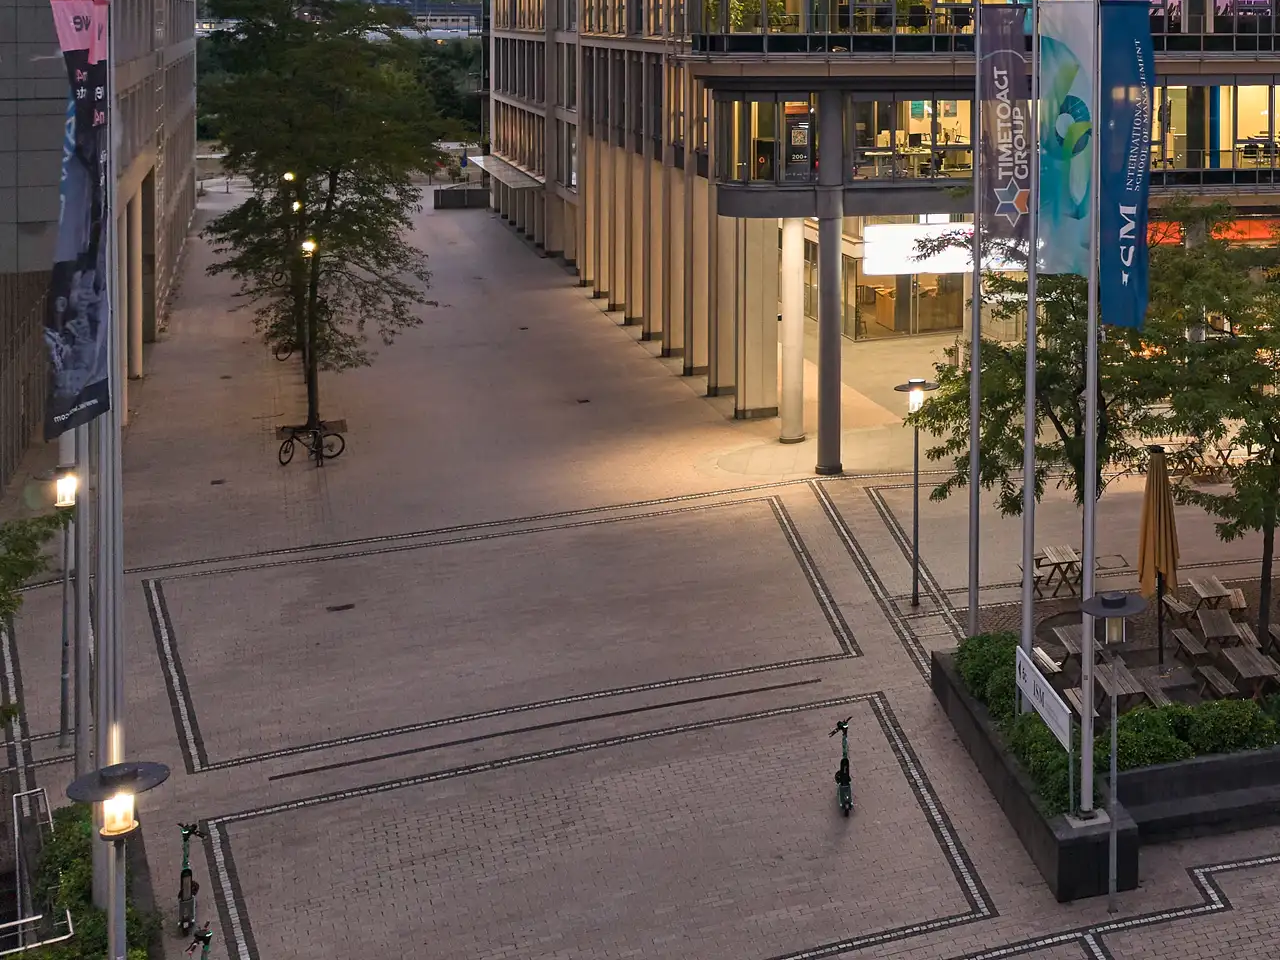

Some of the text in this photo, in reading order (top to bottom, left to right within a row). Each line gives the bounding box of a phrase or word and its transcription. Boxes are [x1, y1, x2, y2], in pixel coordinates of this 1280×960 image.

[993, 66, 1013, 180] TIMETOACT
[1012, 106, 1029, 180] GROUP
[1126, 96, 1144, 192] INTERNATIONAL
[1134, 39, 1149, 192] SCHOOL OF MANAGEMENT
[1118, 203, 1138, 287] ISM
